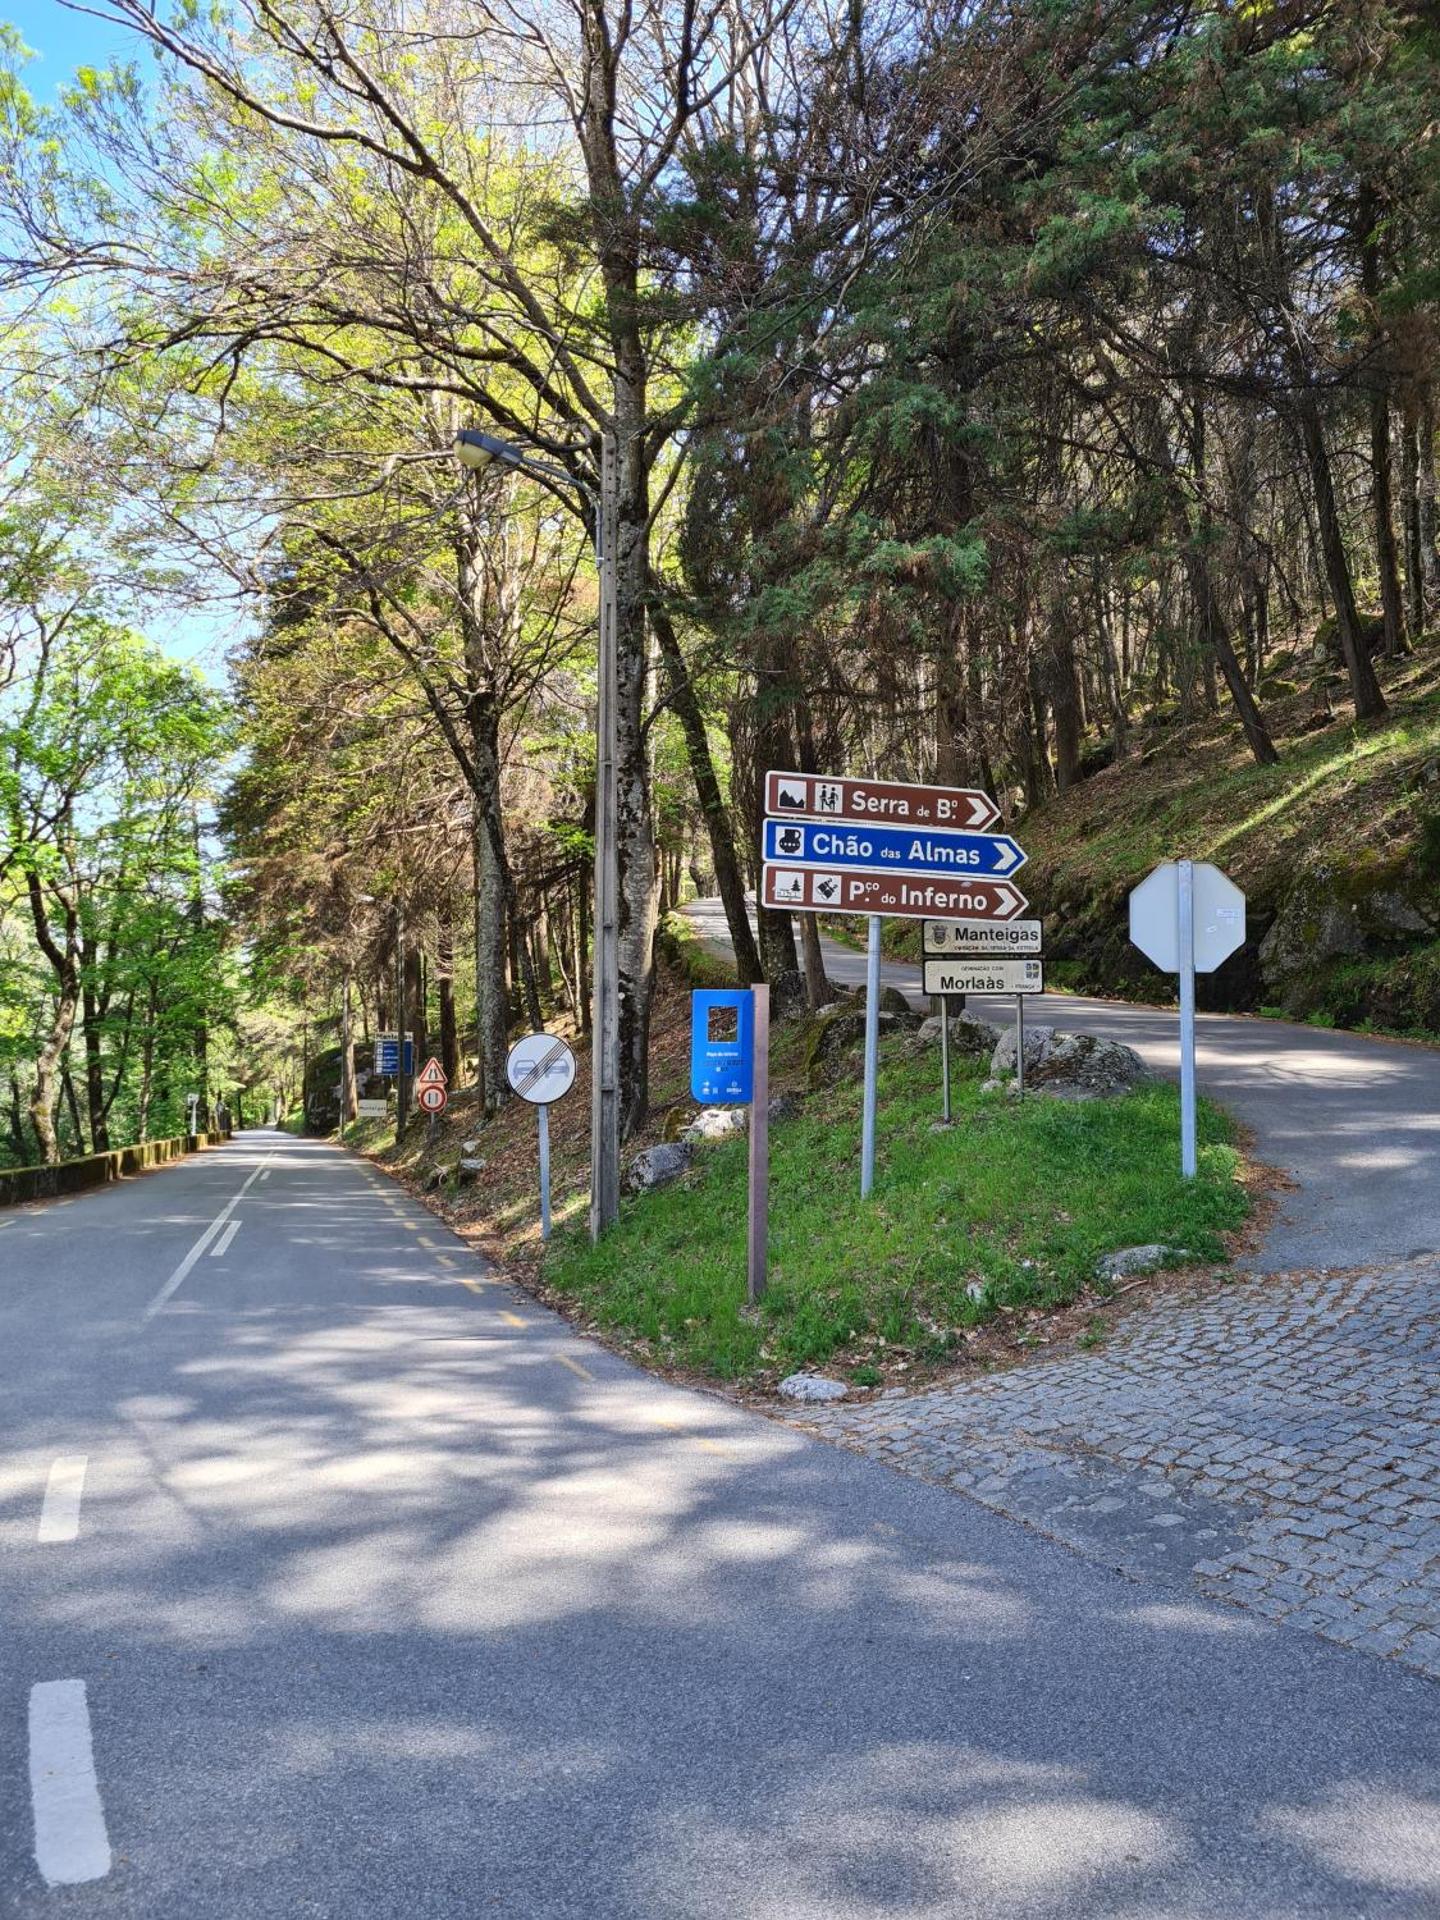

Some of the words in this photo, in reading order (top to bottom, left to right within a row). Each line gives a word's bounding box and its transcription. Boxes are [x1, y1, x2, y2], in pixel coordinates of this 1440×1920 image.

[851, 790, 910, 816] Serra
[916, 804, 930, 818] de
[812, 833, 873, 857] Chão
[880, 847, 901, 860] das
[908, 840, 980, 865] Almas
[881, 893, 896, 905] do
[901, 884, 988, 911] Inferno
[955, 927, 1039, 944] Manteigas
[940, 976, 1005, 990] Morlaàs
